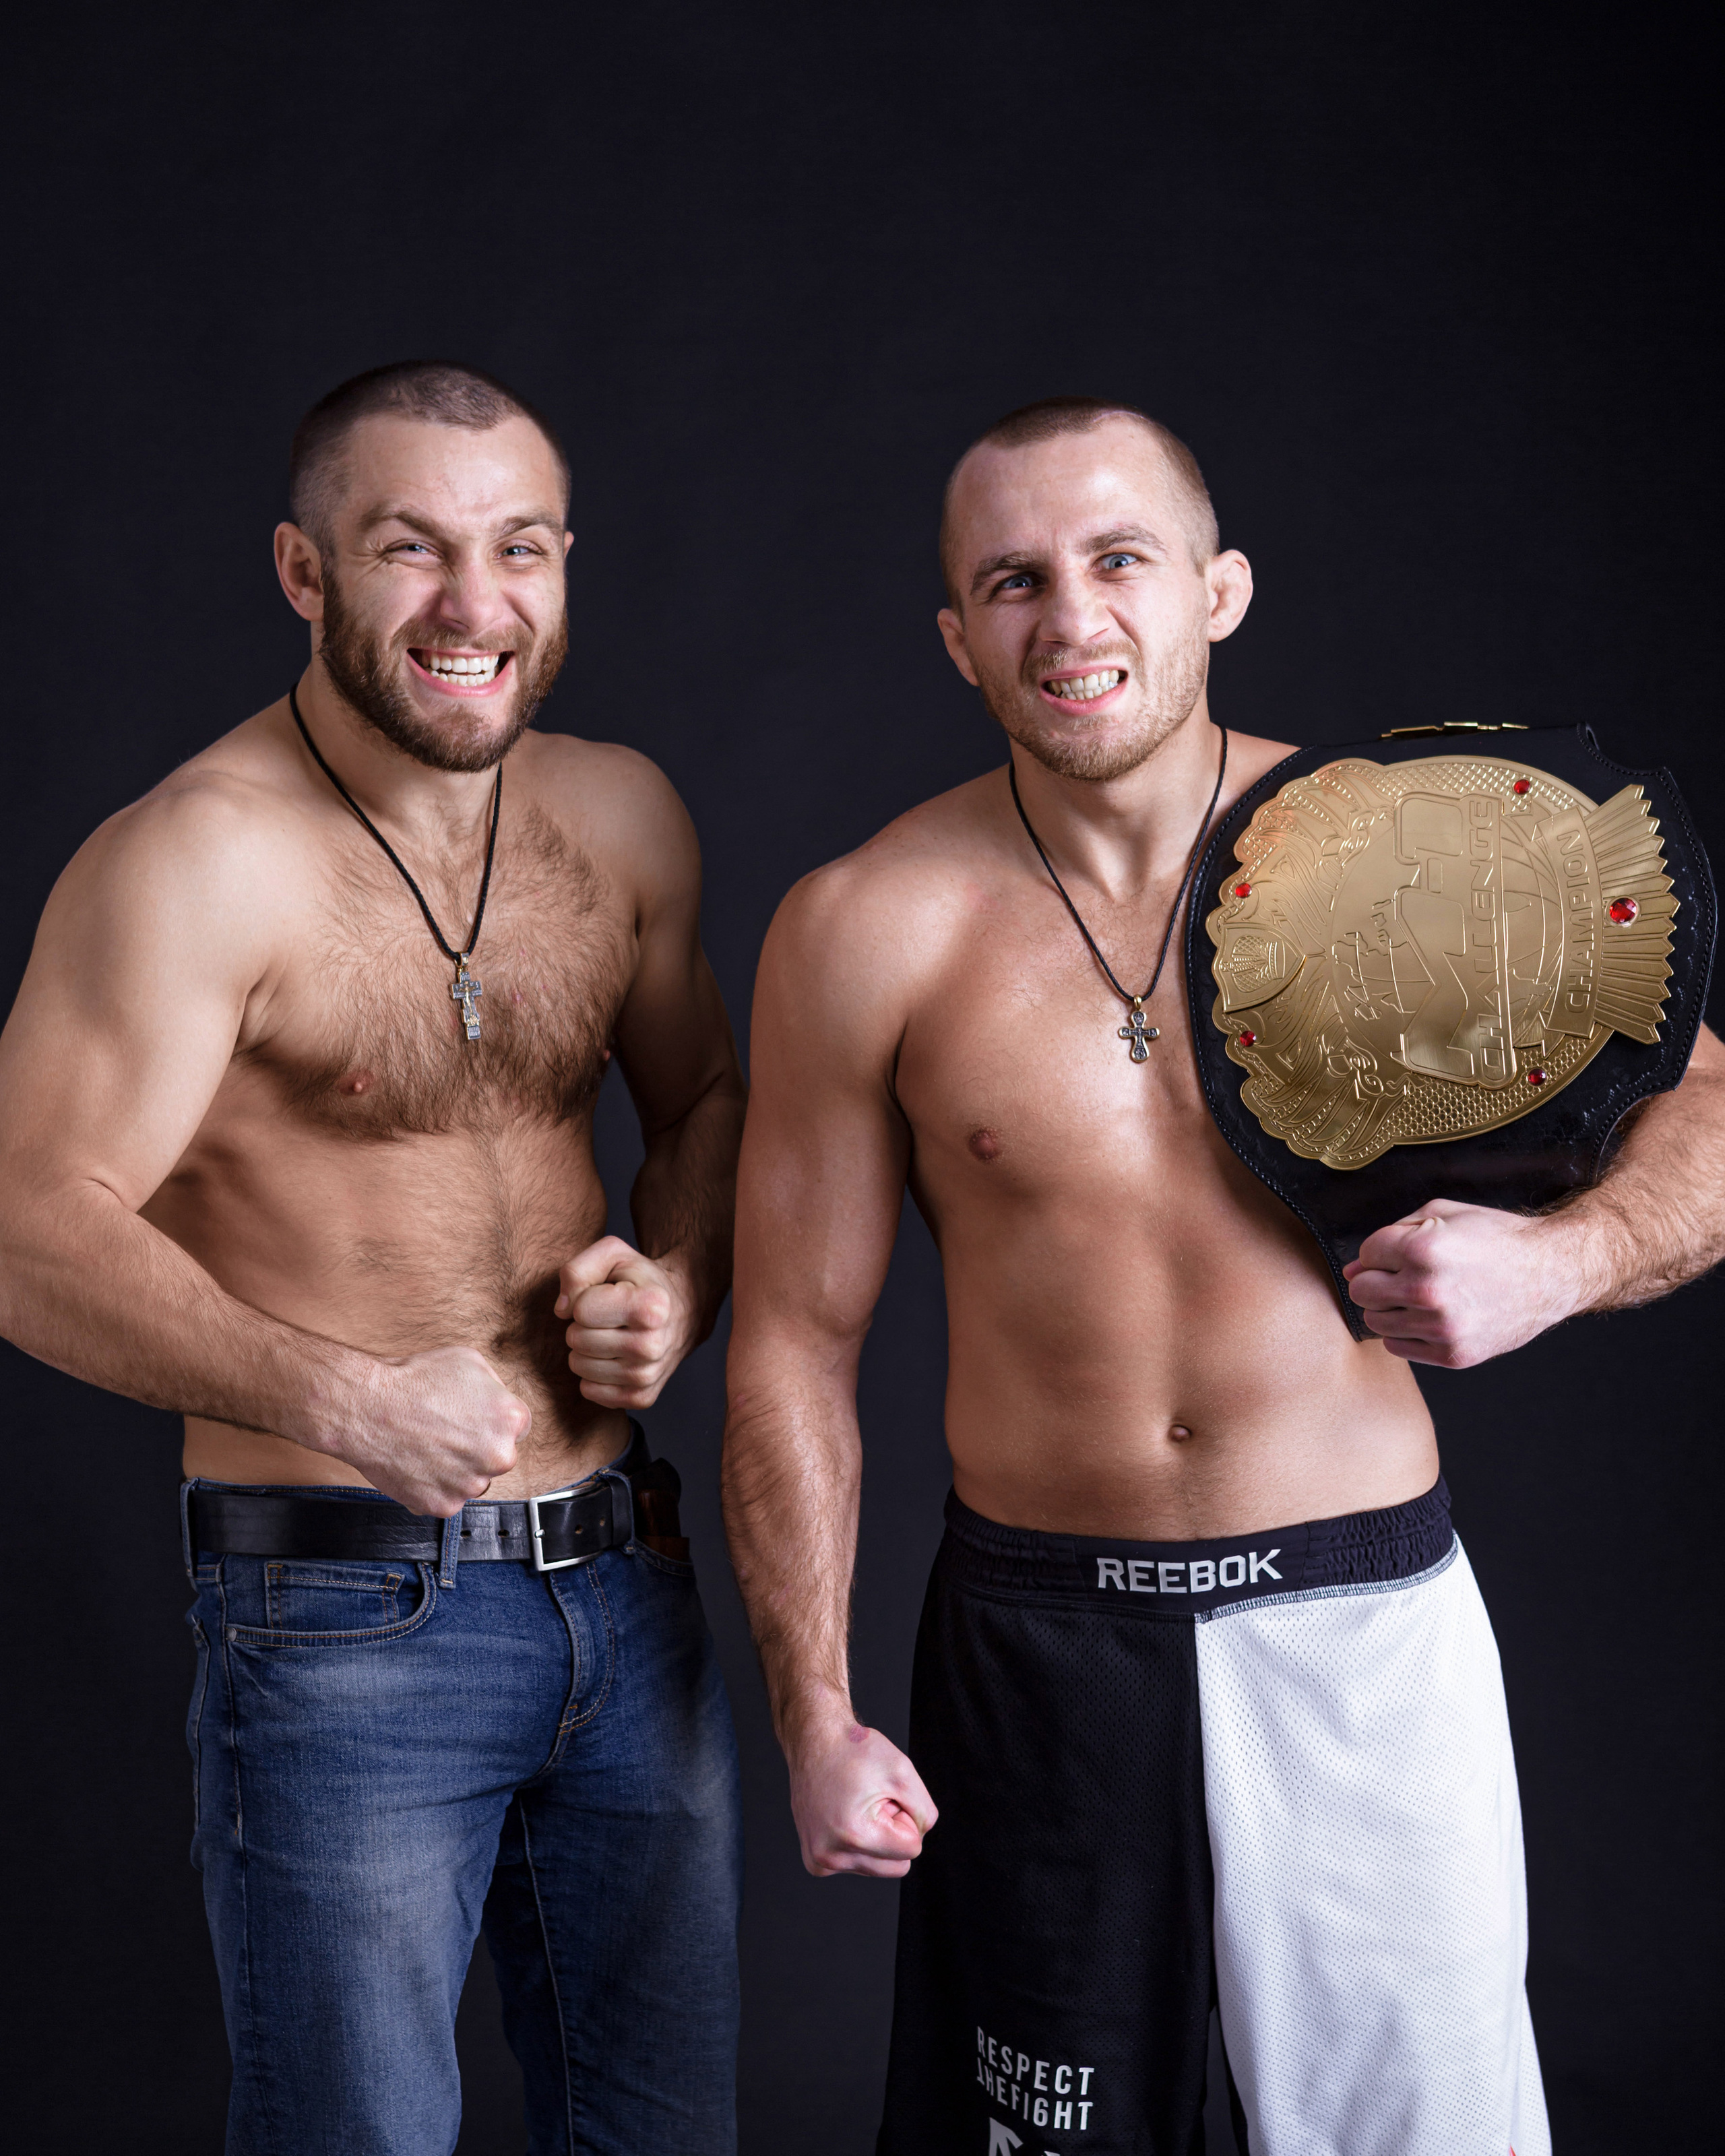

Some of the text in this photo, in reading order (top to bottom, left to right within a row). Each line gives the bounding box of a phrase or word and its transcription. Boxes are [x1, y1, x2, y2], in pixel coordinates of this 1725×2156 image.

[1400, 796, 1476, 1078] M-1
[1468, 800, 1507, 1079] CHALLENGE
[1557, 829, 1595, 1013] CHAMPION
[1096, 1548, 1284, 1593] REEBOK
[977, 2025, 1095, 2096] RESPECT
